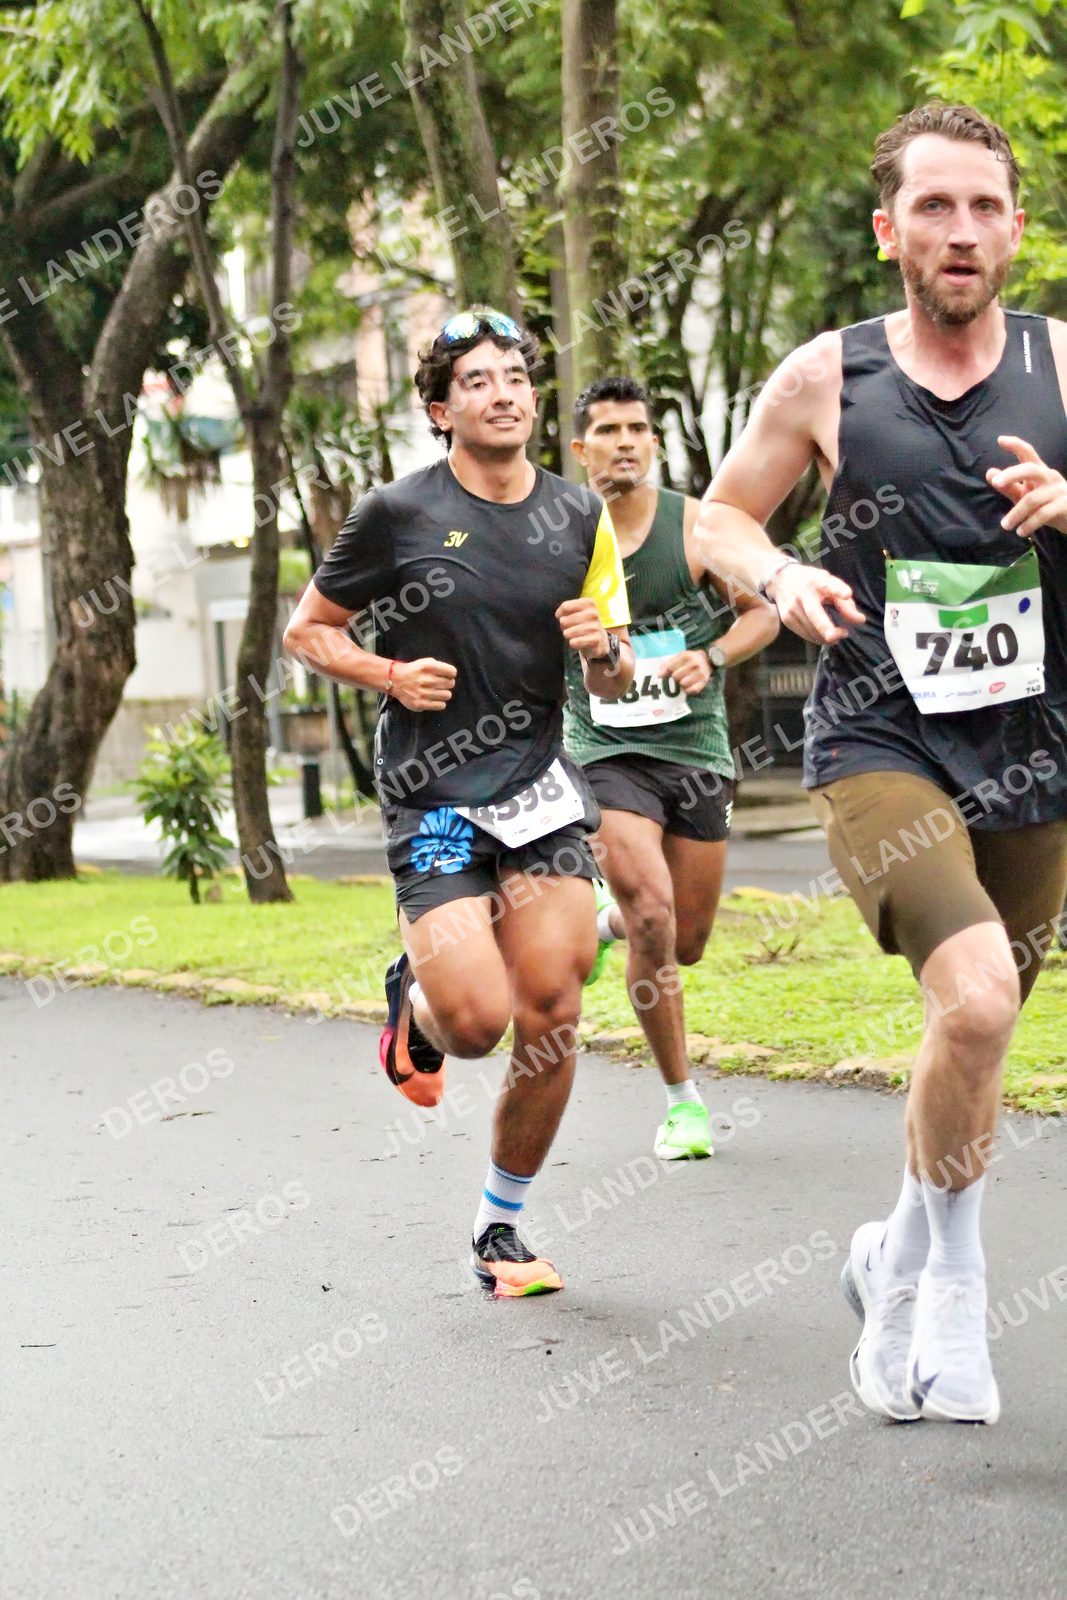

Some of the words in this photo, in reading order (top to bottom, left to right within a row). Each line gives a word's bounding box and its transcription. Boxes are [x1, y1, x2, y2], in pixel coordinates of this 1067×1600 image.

[444, 531, 468, 547] 3V
[915, 622, 1019, 676] 740
[600, 675, 680, 705] 840
[1025, 684, 1041, 694] 740
